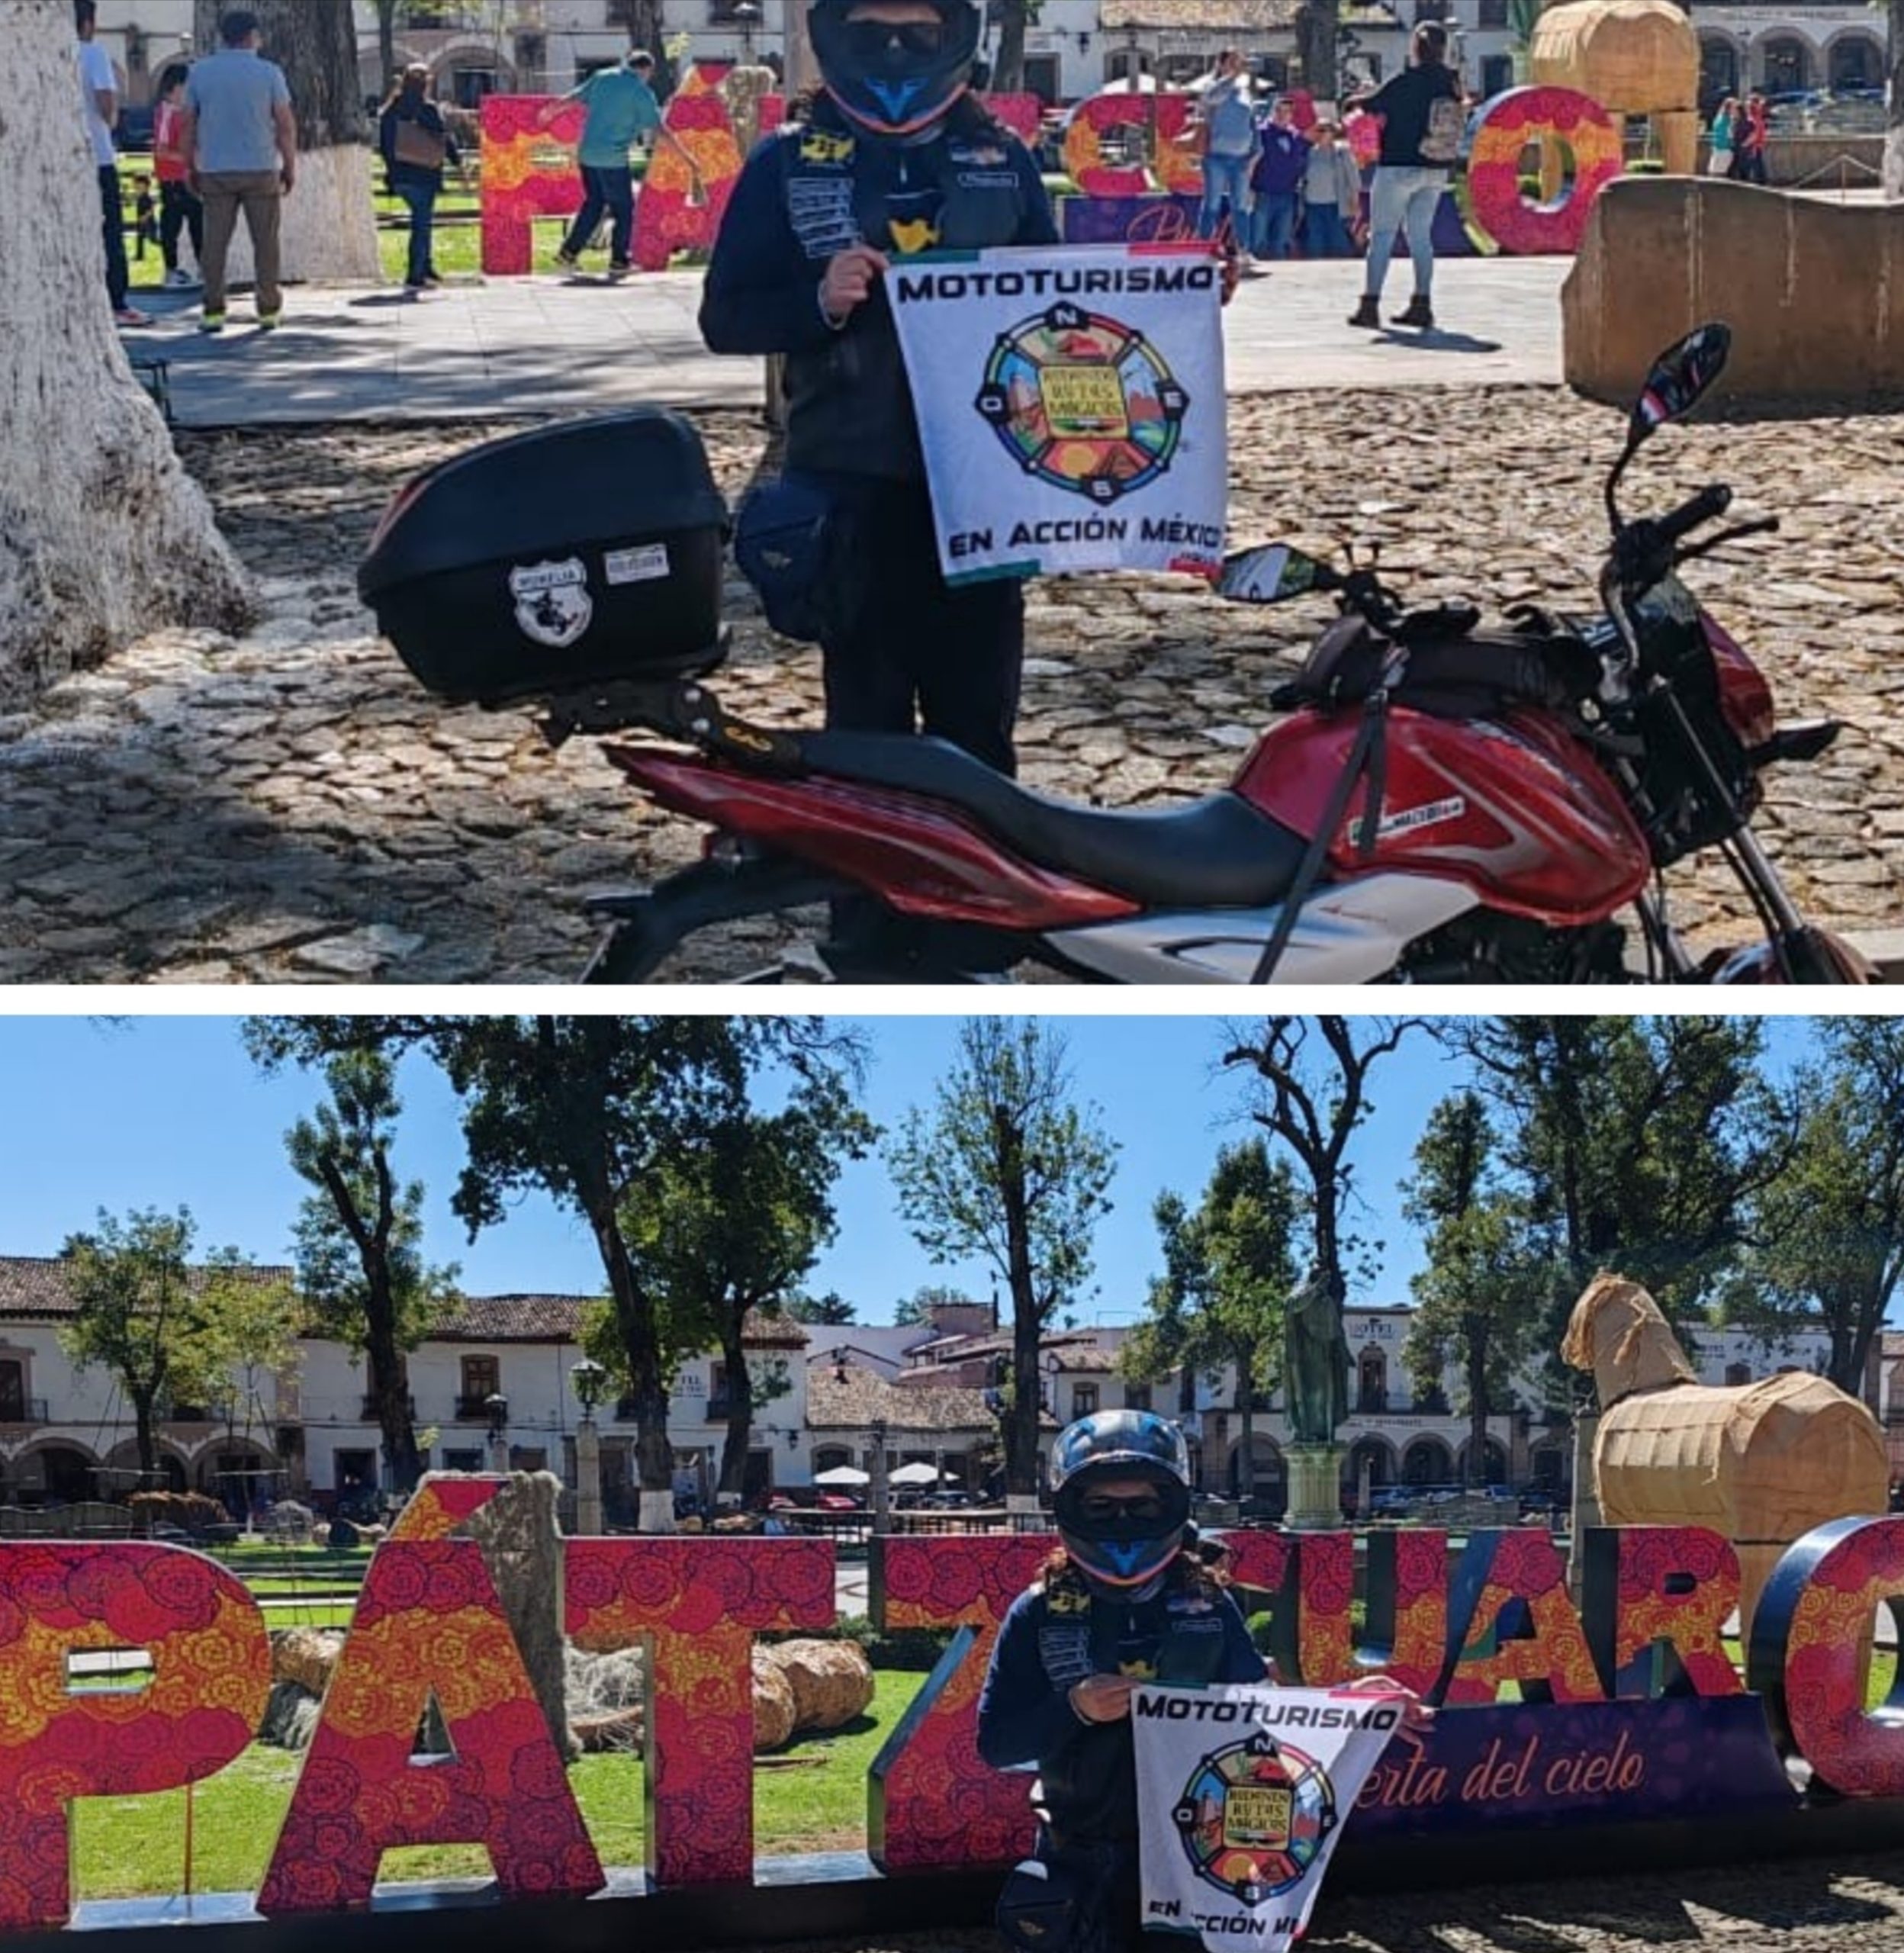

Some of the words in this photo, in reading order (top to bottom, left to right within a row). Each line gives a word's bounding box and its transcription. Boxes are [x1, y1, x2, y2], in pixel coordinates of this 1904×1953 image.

[898, 265, 1213, 303] MOTOTURISMO
[1054, 309, 1077, 324] N
[1163, 392, 1182, 407] E
[948, 528, 992, 558] EN
[1008, 511, 1127, 547] ACCIÓN
[1140, 512, 1221, 548] MÉXIC
[1136, 1693, 1399, 1730] MOTOTURISMO
[1254, 1738, 1272, 1751] N
[1354, 1742, 1448, 1808] erta
[1462, 1734, 1539, 1801] del
[1545, 1729, 1645, 1794] cielo
[1149, 1900, 1181, 1916] EN
